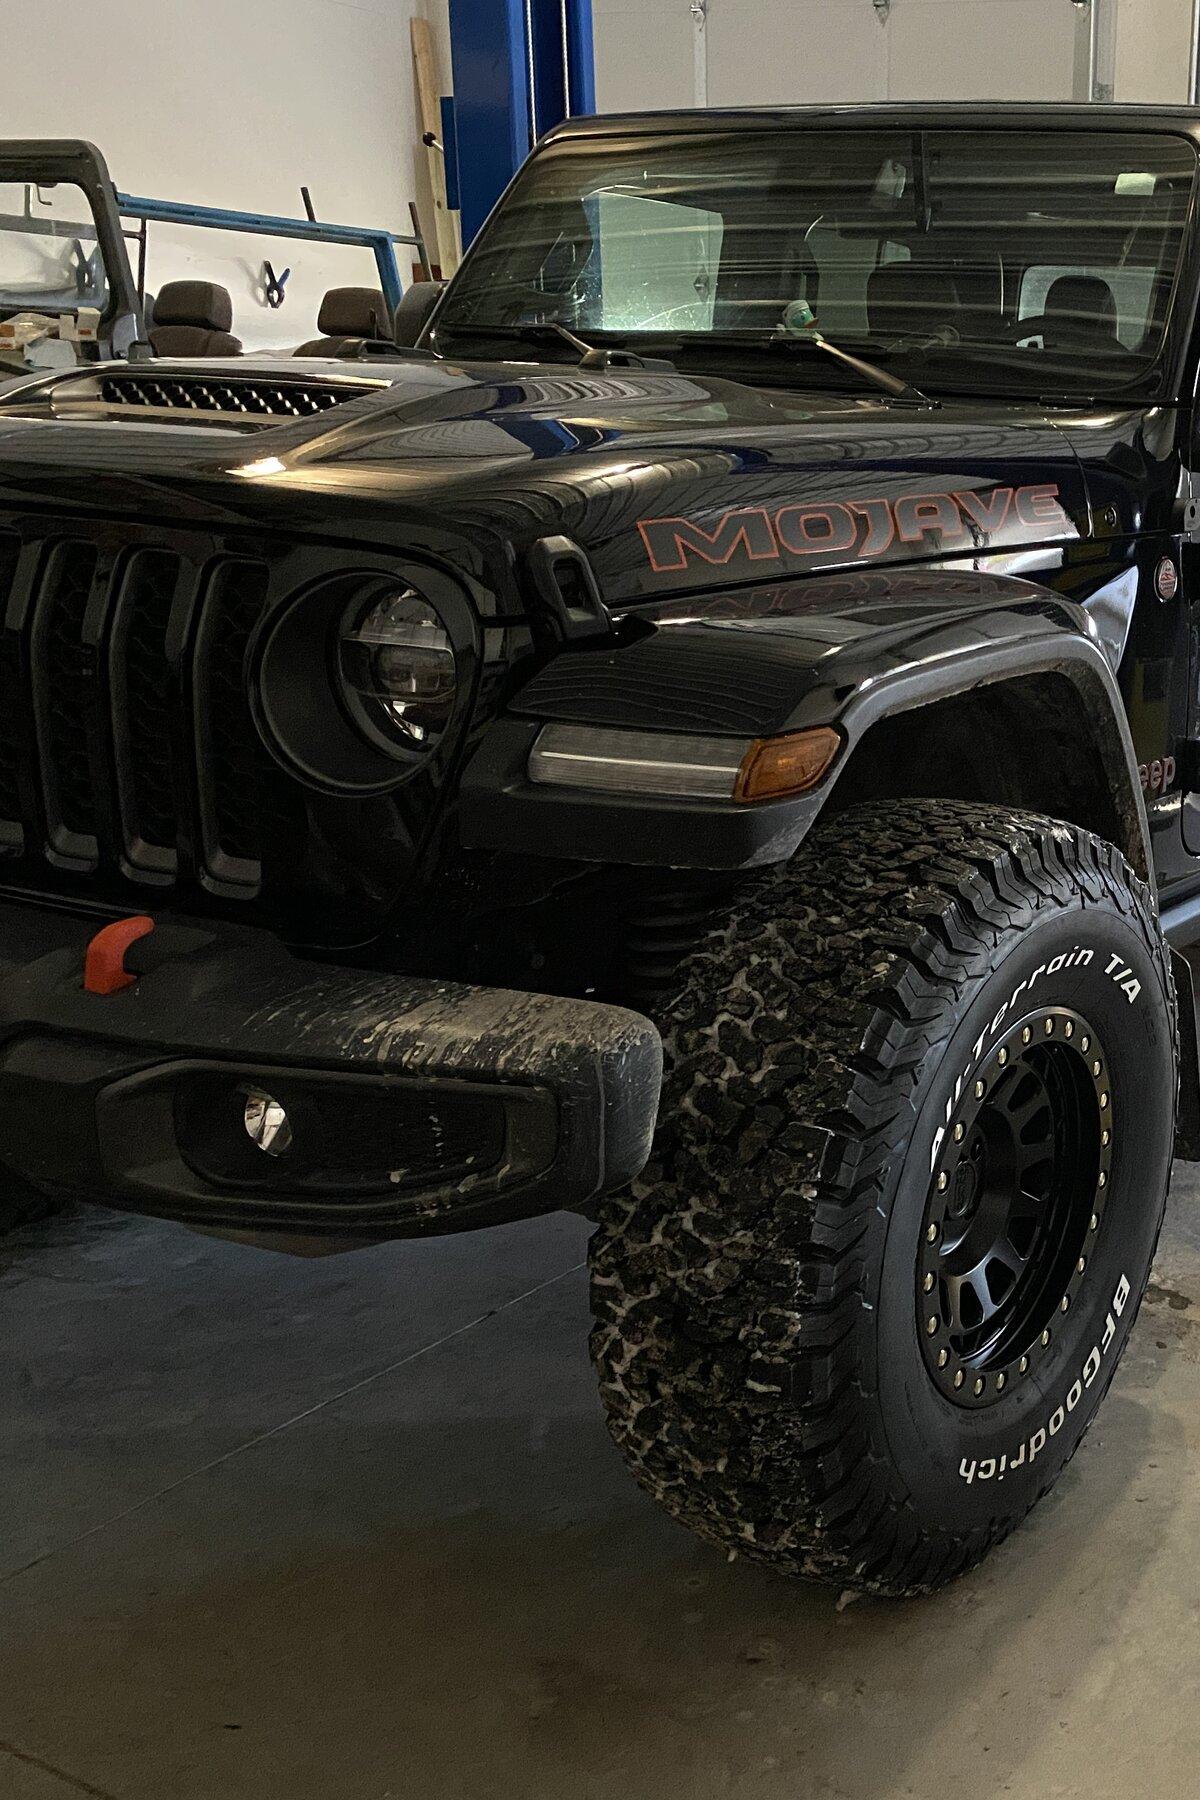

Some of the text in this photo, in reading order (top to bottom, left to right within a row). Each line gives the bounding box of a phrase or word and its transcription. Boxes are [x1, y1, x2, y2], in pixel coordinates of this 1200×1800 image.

[636, 483, 1067, 572] MOJAVE
[1138, 756, 1176, 794] eep
[958, 1273, 1131, 1484] BFGoodrich
